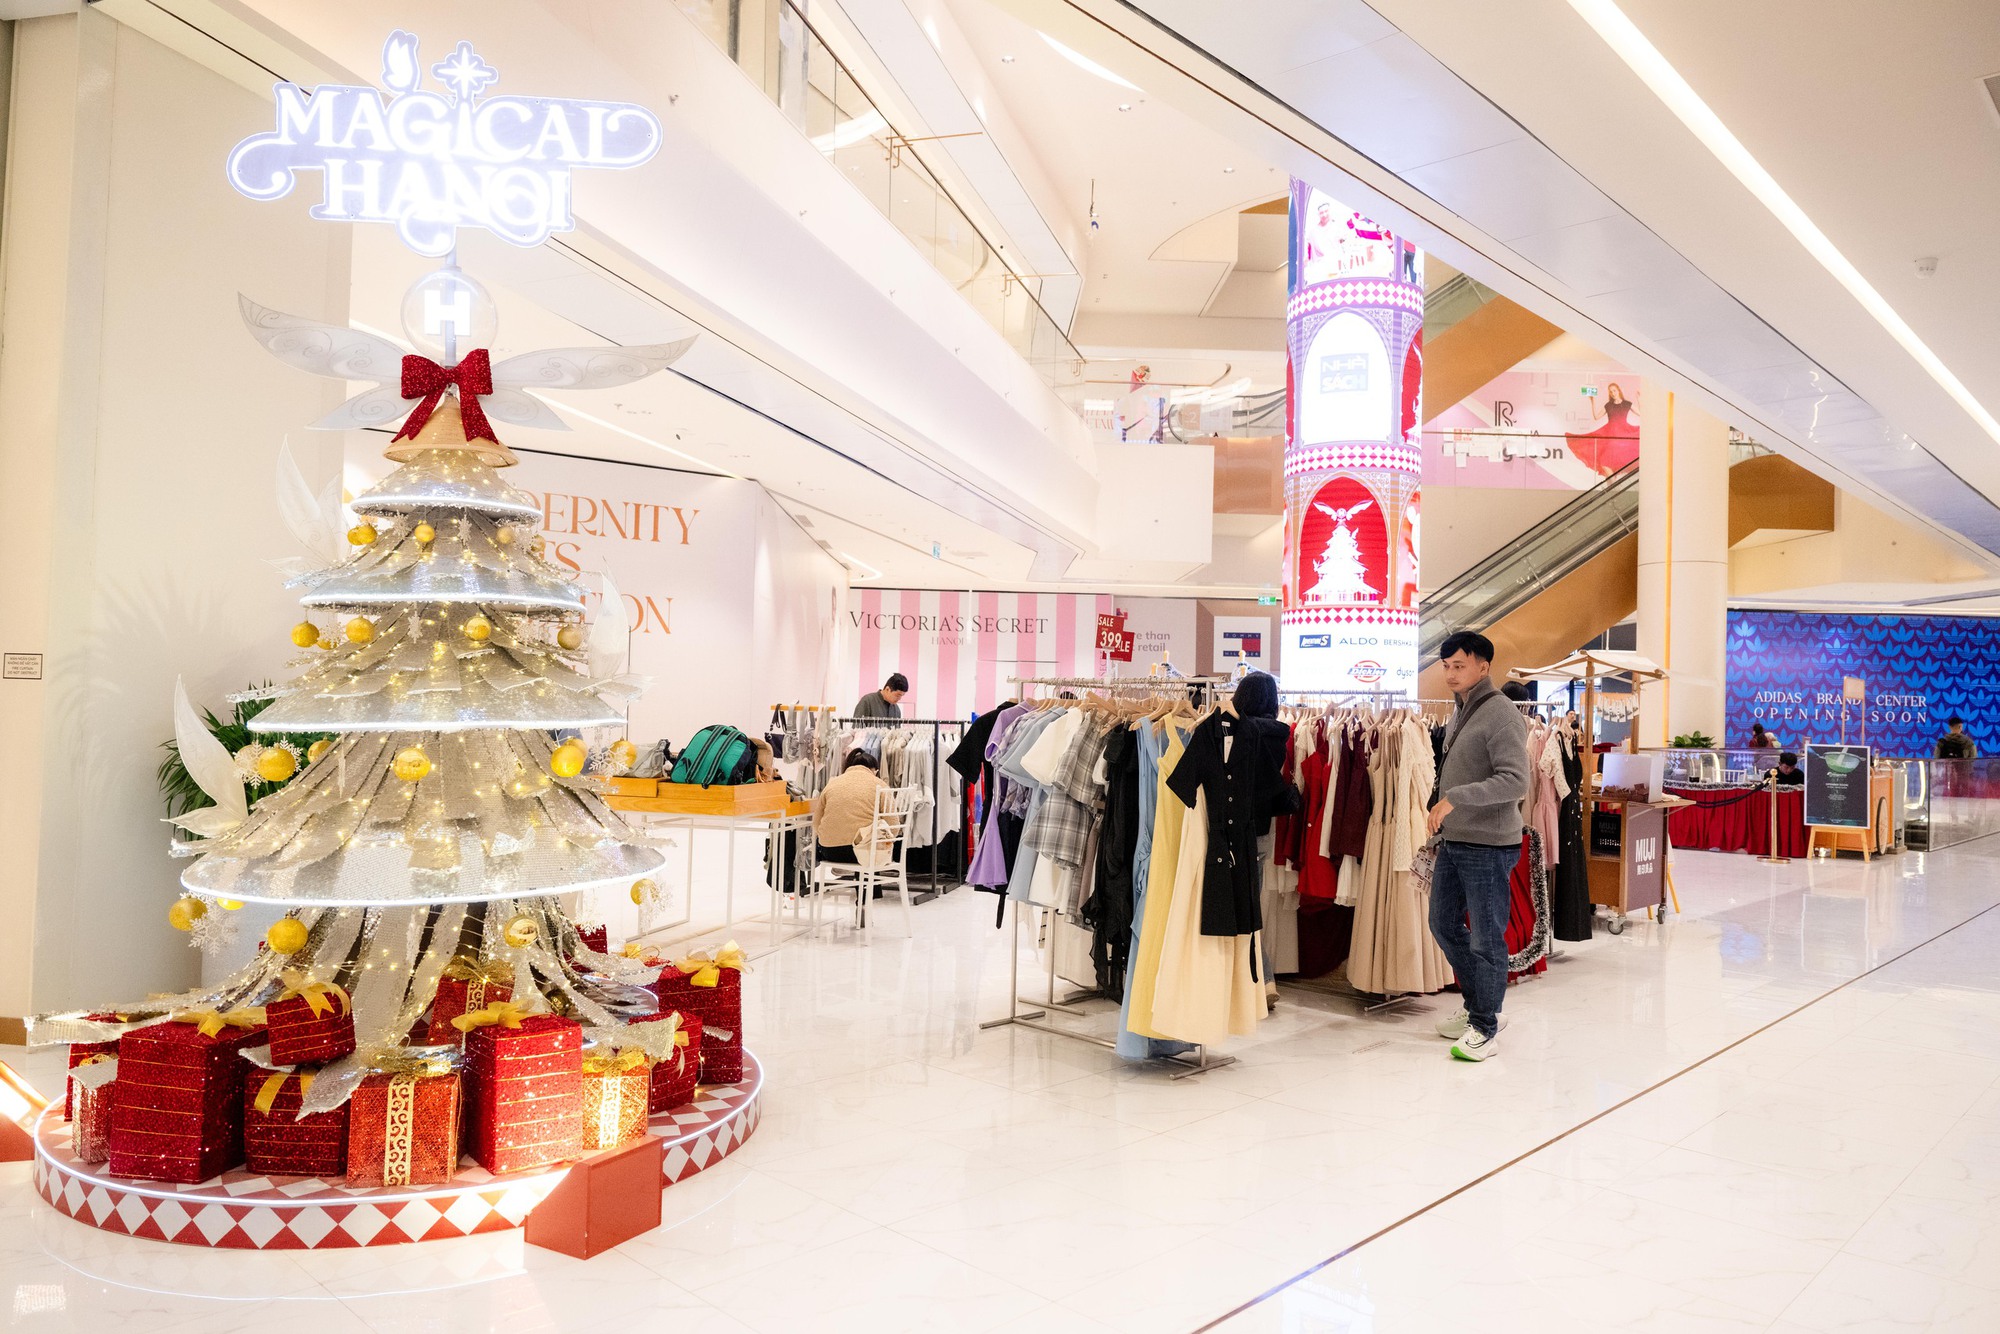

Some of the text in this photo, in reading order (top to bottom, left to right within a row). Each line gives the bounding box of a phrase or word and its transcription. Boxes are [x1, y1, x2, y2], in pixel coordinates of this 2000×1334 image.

[322, 157, 574, 245] HANOI
[424, 289, 471, 337] H
[849, 611, 1049, 634] VICTORIA'S SECRET
[1098, 616, 1114, 628] SALE
[1100, 630, 1122, 649] 399
[1145, 630, 1171, 641] than
[1339, 637, 1378, 645] ALDO
[1137, 642, 1166, 652] retail
[1754, 691, 1927, 707] ADIDAS BRAND CENTER
[1754, 707, 1927, 723] OPENING SOON
[1635, 837, 1656, 863] MUJI
